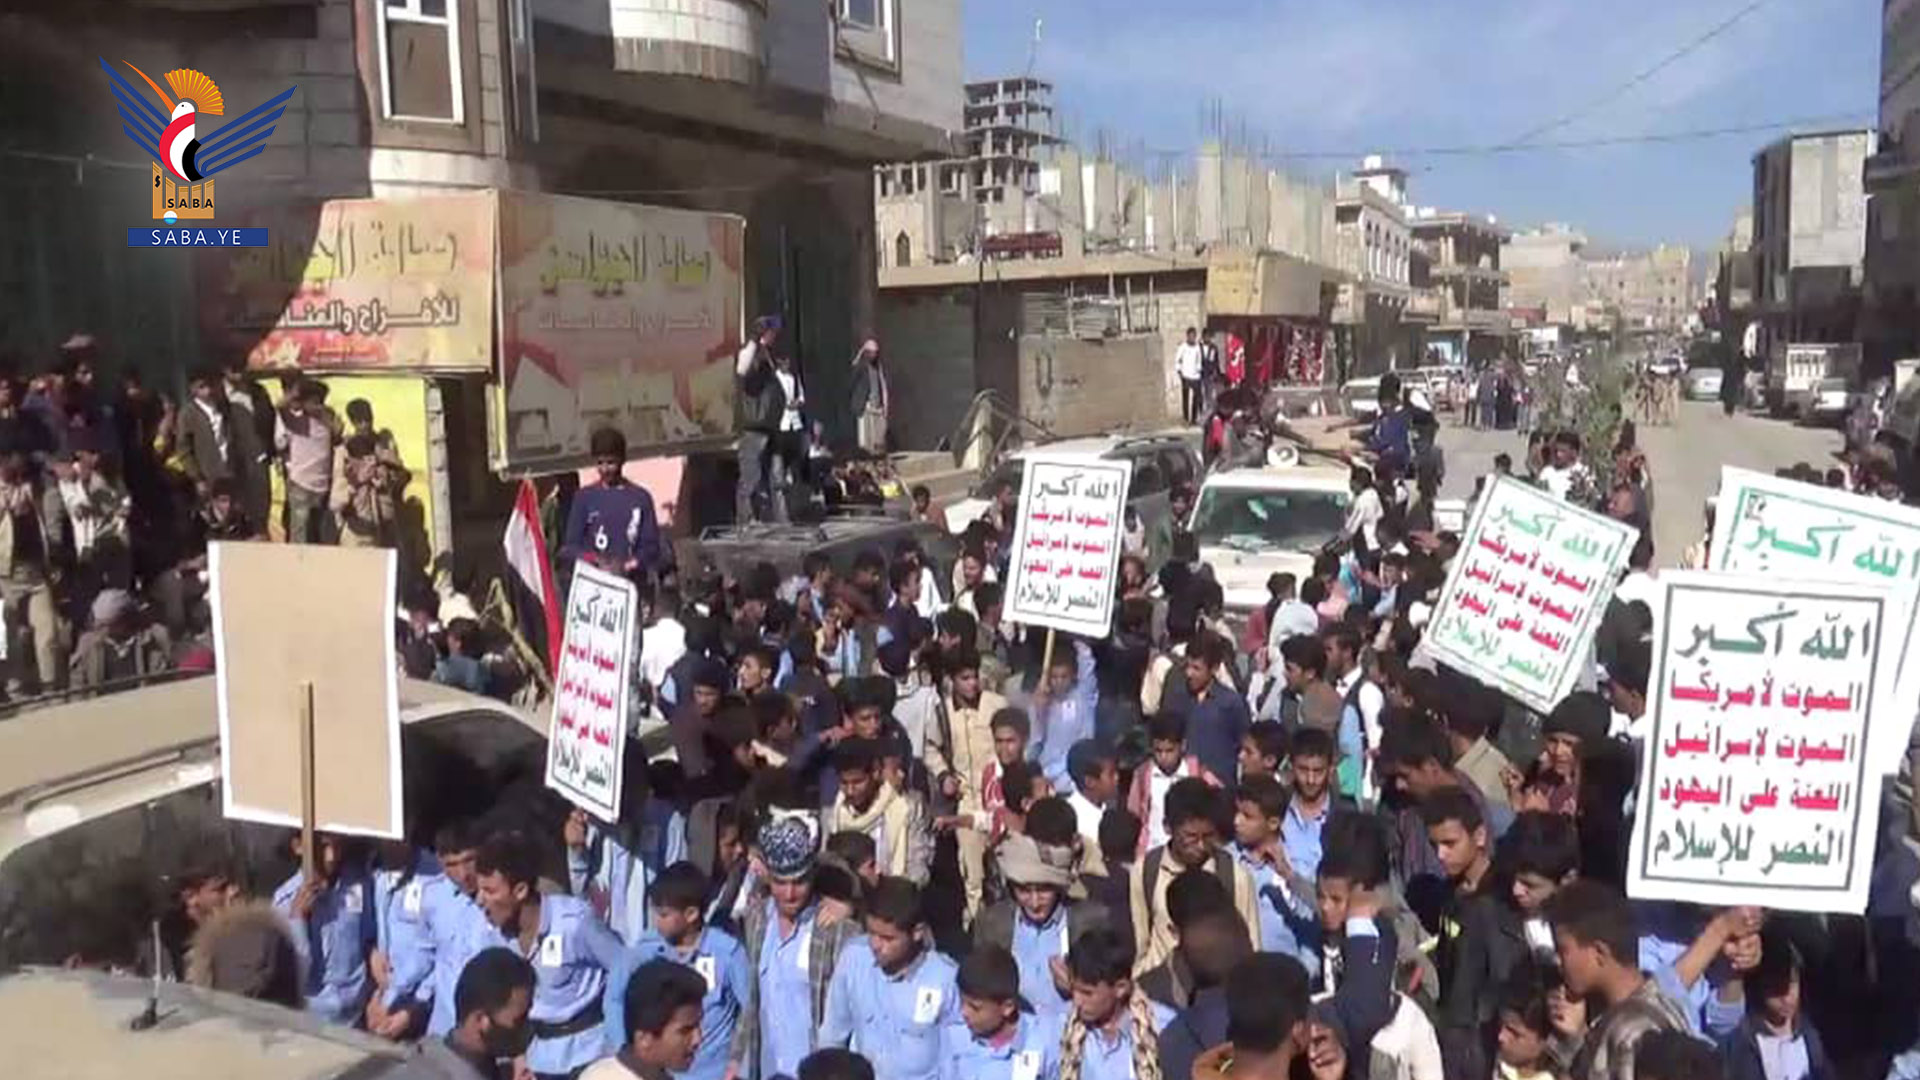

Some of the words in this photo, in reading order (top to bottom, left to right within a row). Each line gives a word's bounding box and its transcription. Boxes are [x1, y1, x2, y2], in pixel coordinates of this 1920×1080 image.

[1085, 478, 1117, 499] الله
[1562, 532, 1612, 563] الله
[1853, 532, 1920, 580] الله
[600, 598, 624, 633] الله
[1674, 602, 1799, 666] أكبر
[1798, 611, 1871, 661] الله
[1781, 682, 1863, 716] الموت
[1776, 732, 1856, 767] الموت
[1659, 775, 1733, 813] اليهود
[1740, 783, 1779, 815] على
[1788, 778, 1850, 813] اللعنة
[1760, 822, 1844, 876] النصر
